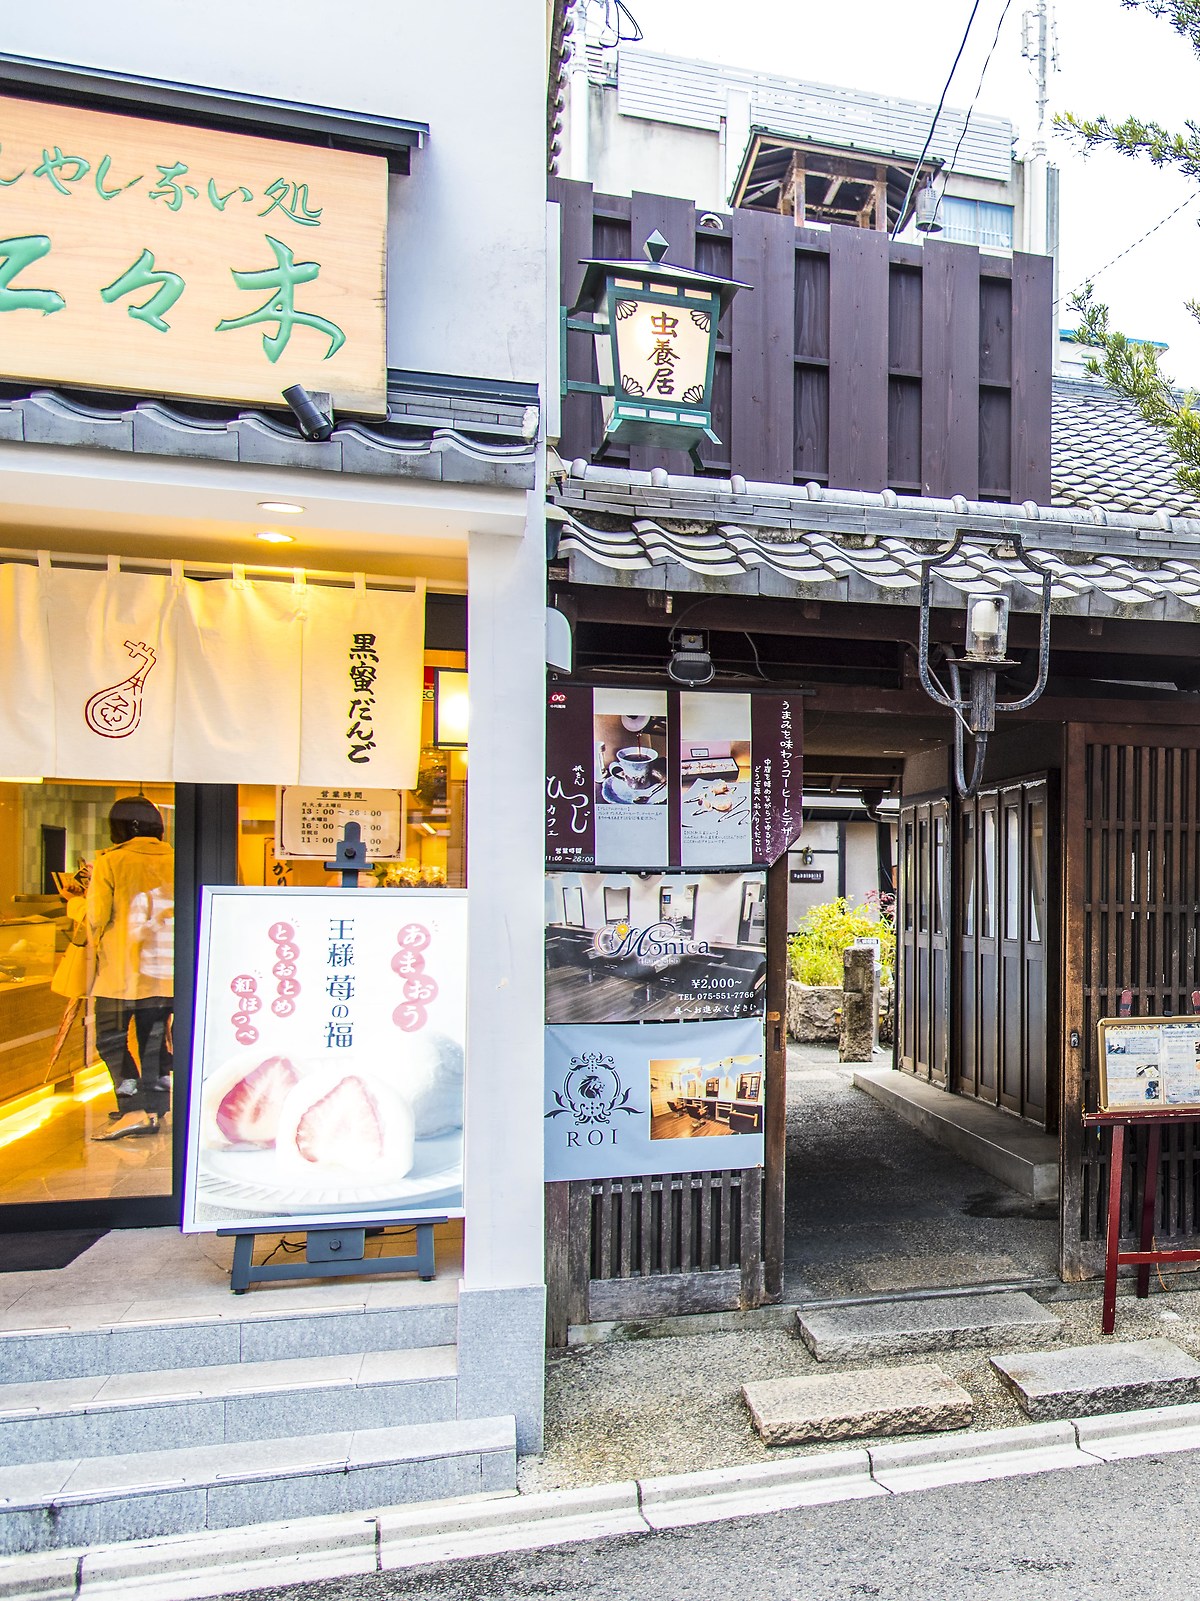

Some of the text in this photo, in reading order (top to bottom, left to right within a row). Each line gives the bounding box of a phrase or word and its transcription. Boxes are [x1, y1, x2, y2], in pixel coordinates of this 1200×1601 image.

[647, 311, 680, 395] 虫養居
[345, 632, 379, 764] 黒蜜だんご
[320, 790, 363, 799] 営業時間
[546, 775, 591, 834] ひつじ
[546, 804, 559, 836] カフェ
[609, 921, 710, 957] Monica
[274, 924, 297, 1016] とちおとめ
[396, 925, 436, 1029] あまおう
[233, 976, 260, 1042] 紅ほっぺ
[674, 1004, 757, 1015] 奥へお進みください
[678, 991, 754, 1001] TEL 075-551-7766
[566, 1128, 619, 1148] ROI
